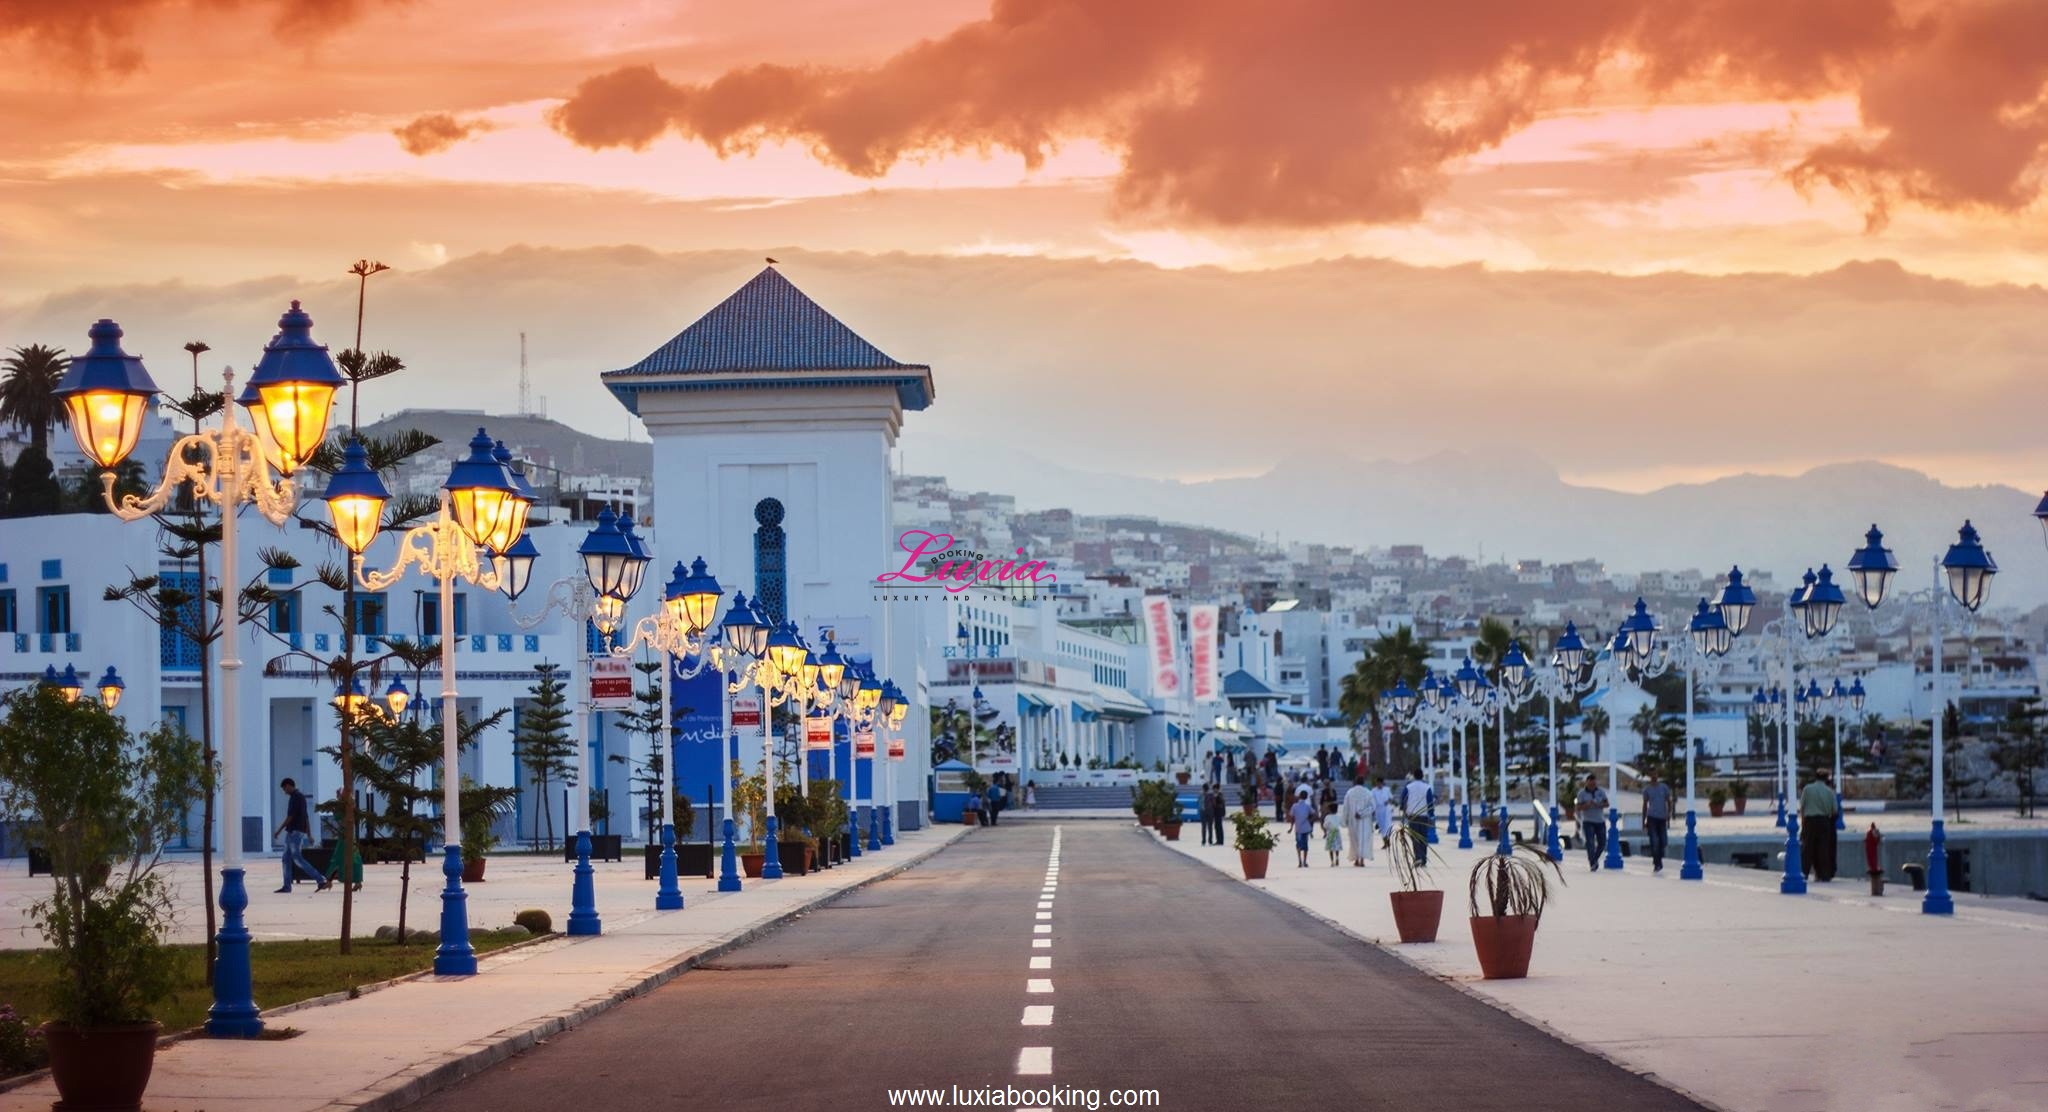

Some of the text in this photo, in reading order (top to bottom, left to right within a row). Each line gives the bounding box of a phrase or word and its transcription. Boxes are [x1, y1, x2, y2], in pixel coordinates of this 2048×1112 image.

[1150, 602, 1173, 667] YAMAHA
[1194, 634, 1211, 697] YAMAHA
[680, 723, 724, 743] M'di
